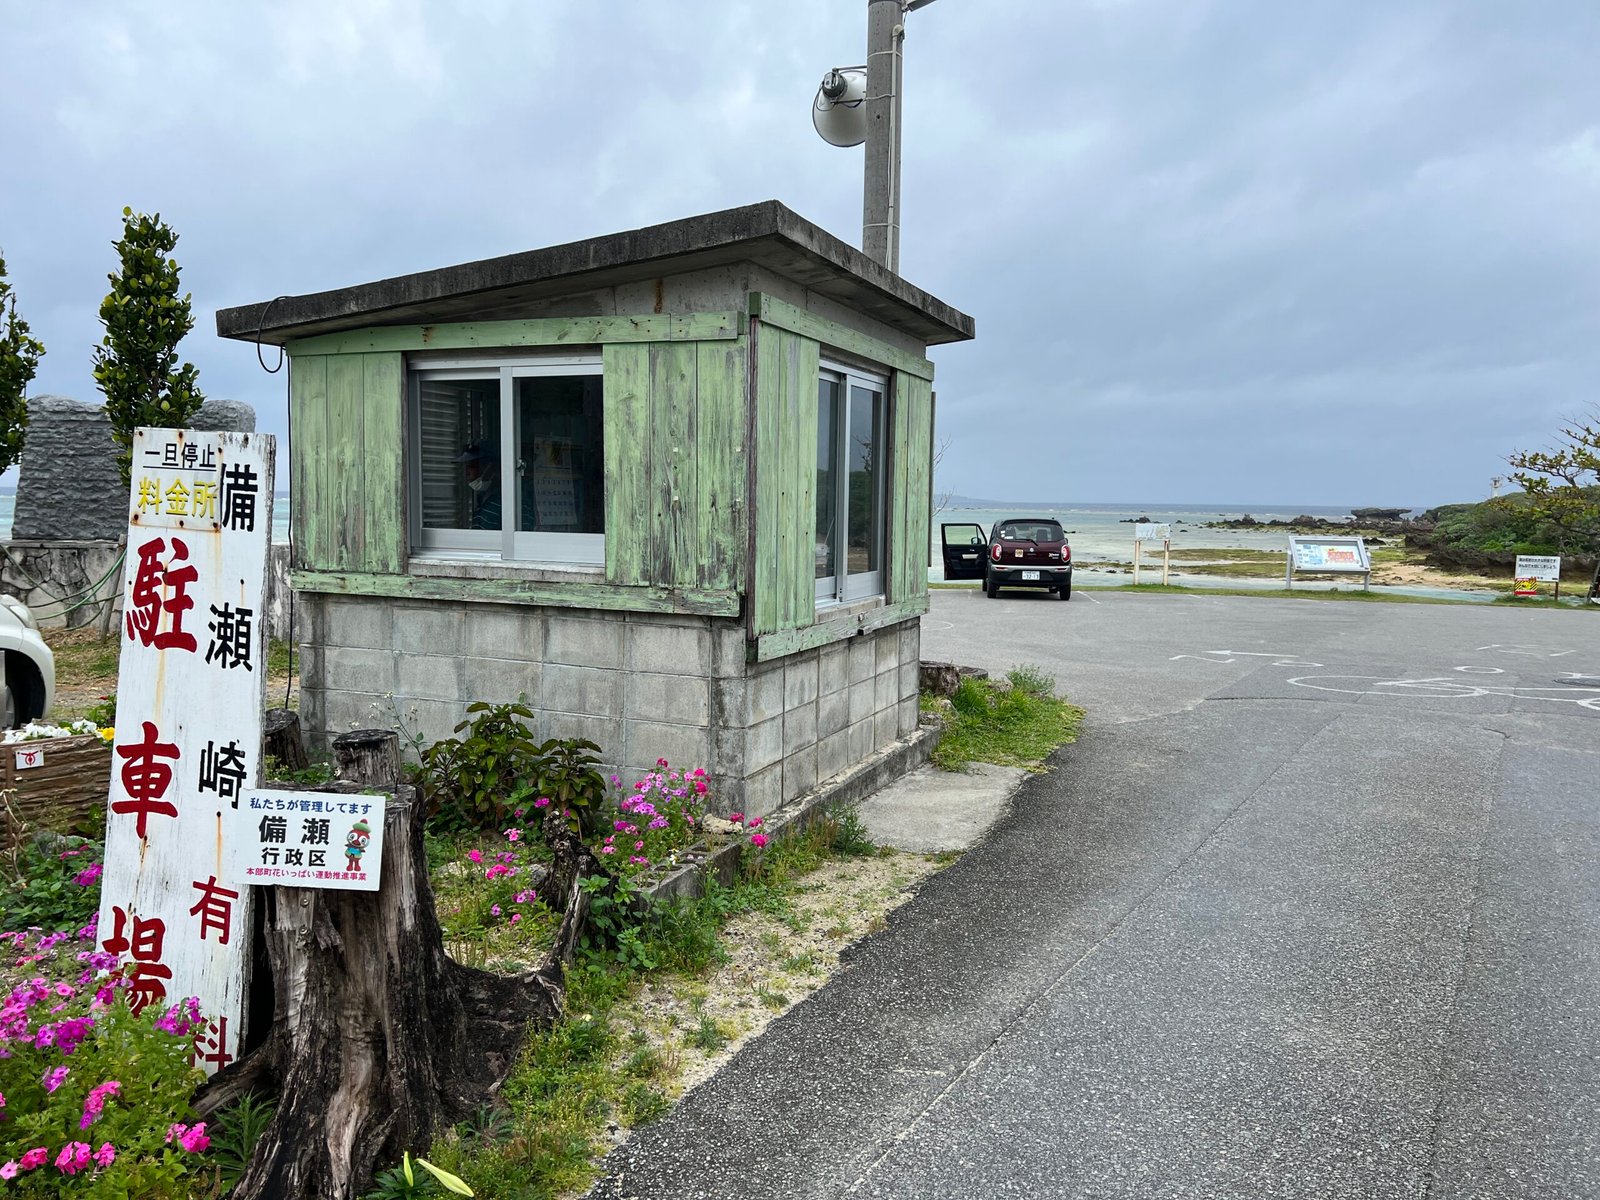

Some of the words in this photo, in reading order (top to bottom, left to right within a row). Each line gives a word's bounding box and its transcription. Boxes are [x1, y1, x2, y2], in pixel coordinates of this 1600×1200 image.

[145, 442, 216, 469] 一旦停止
[137, 476, 220, 519] 料金所
[199, 463, 259, 809] 備瀬崎
[101, 537, 199, 1019] 駐車場
[249, 797, 372, 815] 私たちが管理してます
[258, 815, 331, 845] 備瀬
[261, 846, 327, 867] 行政区
[246, 867, 367, 881] 本部町花いっぱい運動推進事業
